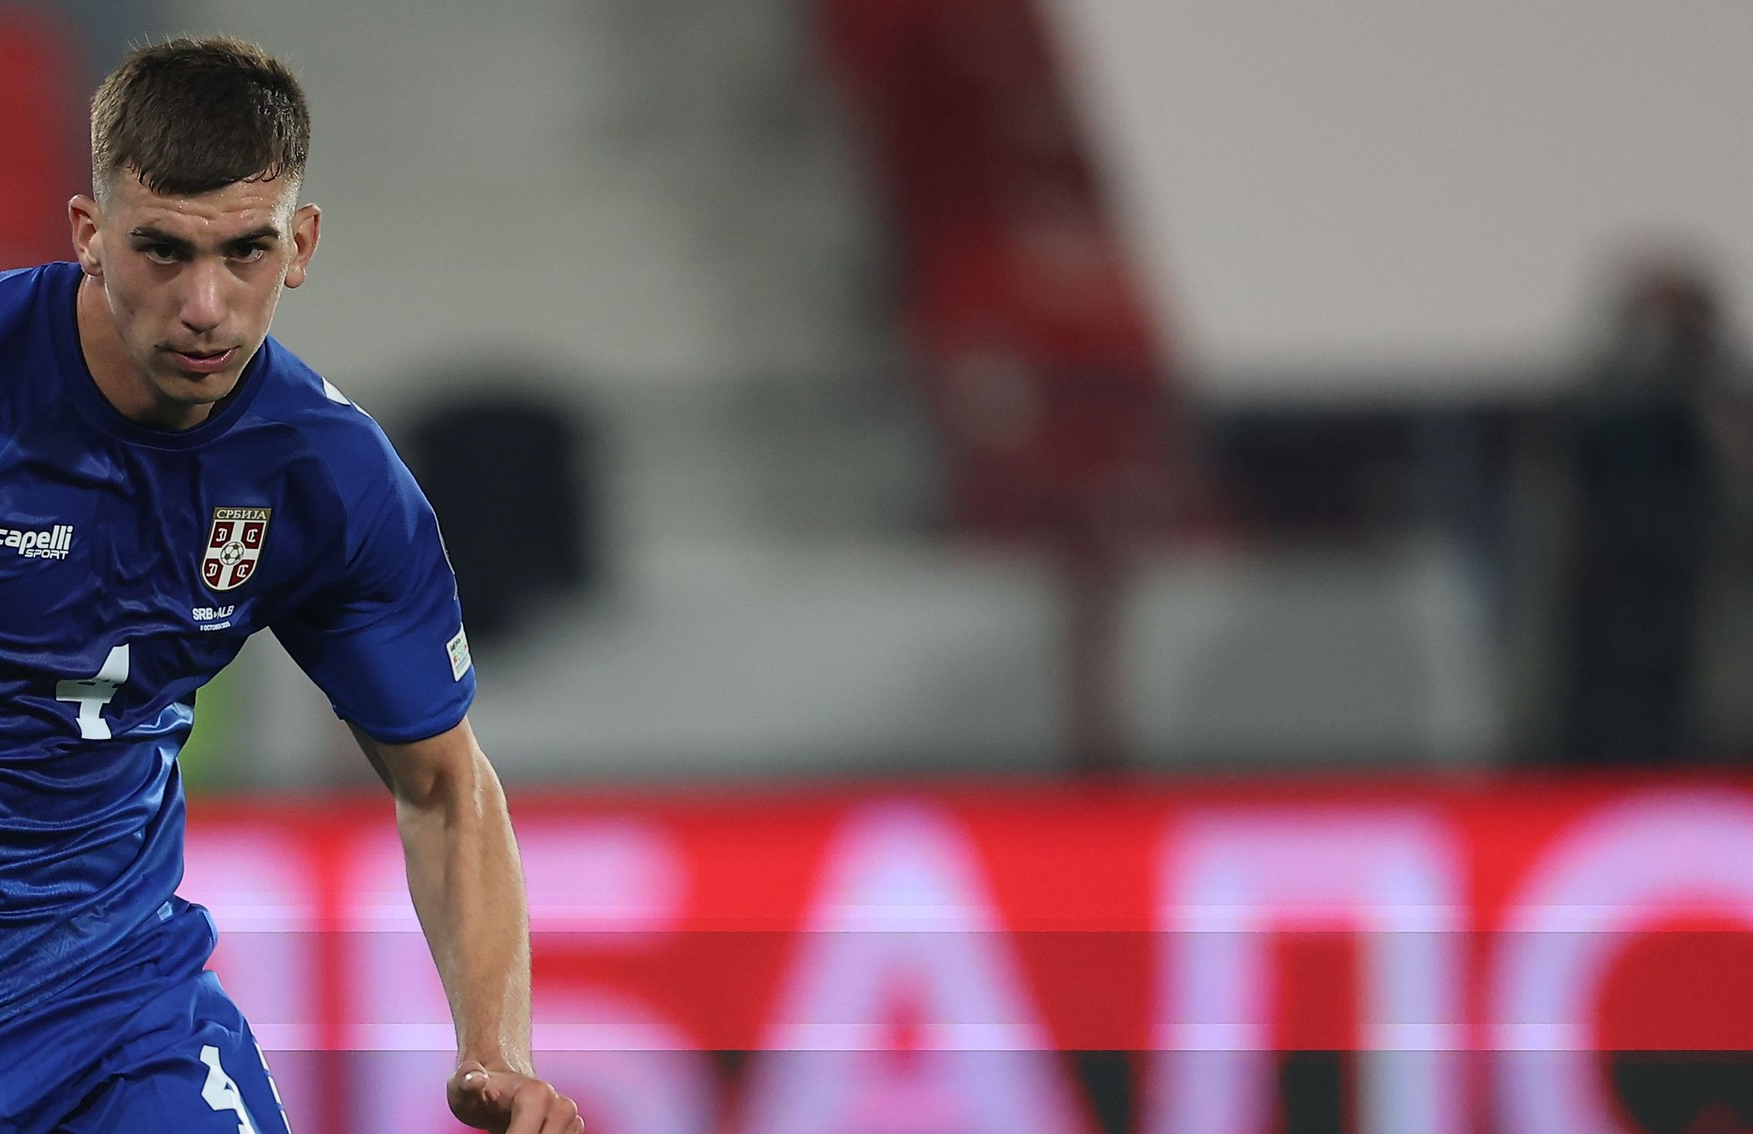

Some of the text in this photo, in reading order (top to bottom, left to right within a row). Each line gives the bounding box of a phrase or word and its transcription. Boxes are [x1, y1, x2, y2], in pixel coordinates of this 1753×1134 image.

[216, 509, 267, 519] СРБИЈА
[25, 549, 69, 559] SPORT
[192, 607, 213, 620] SRB
[56, 643, 129, 740] 4
